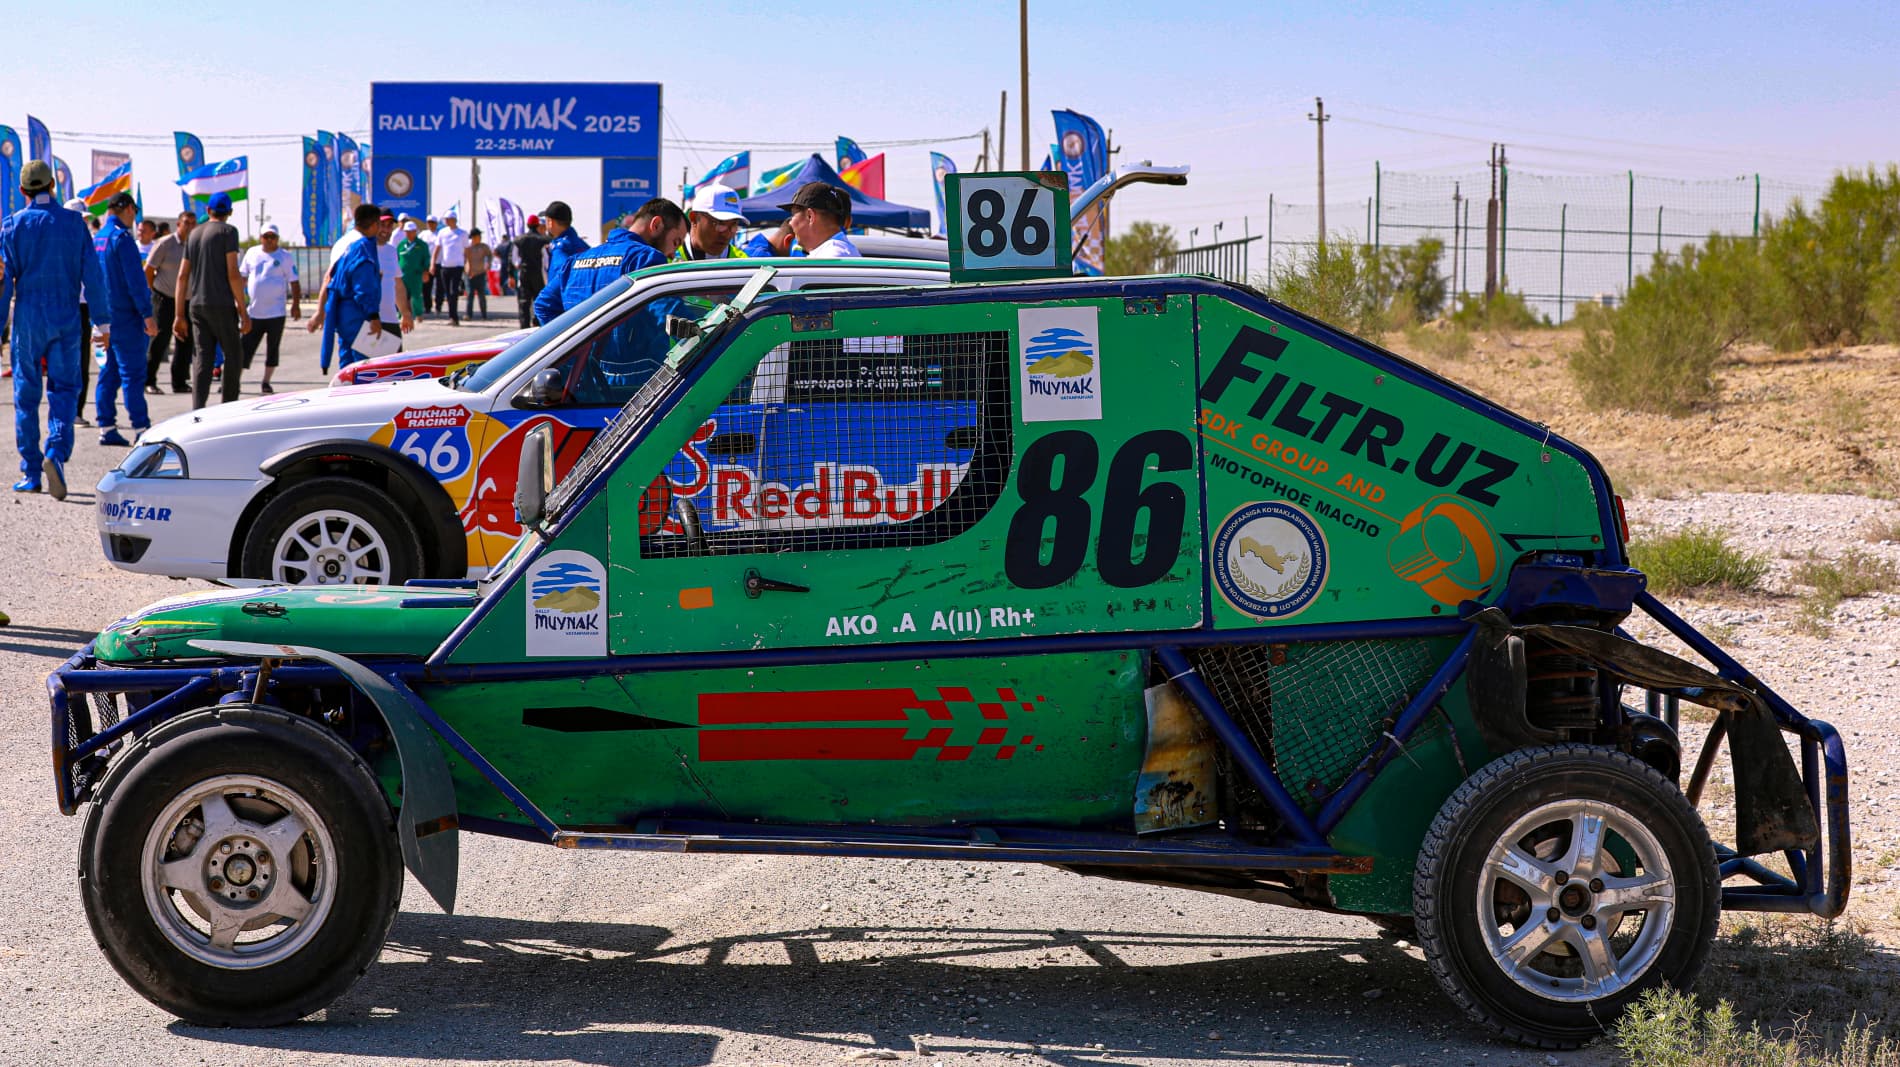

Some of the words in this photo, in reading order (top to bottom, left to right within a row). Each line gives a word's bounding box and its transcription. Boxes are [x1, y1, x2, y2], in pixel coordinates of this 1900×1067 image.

[378, 114, 444, 131] RALLY
[449, 96, 577, 131] MUYNAK
[583, 115, 641, 133] 2025
[474, 138, 555, 151] 22-25-MAY
[967, 188, 1050, 257] 86
[573, 258, 597, 269] RALLY
[595, 255, 622, 268] SPORT
[1029, 377, 1093, 395] MUYNAK
[403, 408, 465, 419] BUKHARA
[408, 417, 457, 428] RACING
[400, 430, 460, 474] 66
[1197, 408, 1243, 439] SDK
[1251, 433, 1329, 476] GROUP
[1336, 473, 1386, 503] AND
[715, 467, 831, 520] Red
[843, 466, 951, 521] Bull
[1210, 453, 1312, 507] МОТОРНОЕ
[1315, 500, 1380, 538] МАСЛО
[101, 499, 172, 522] OODYEAR
[1004, 429, 1194, 590] 86
[1222, 509, 1261, 540] MUDOFAASIGA
[534, 613, 599, 630] MUYNAK
[990, 606, 1035, 628] Rh+
